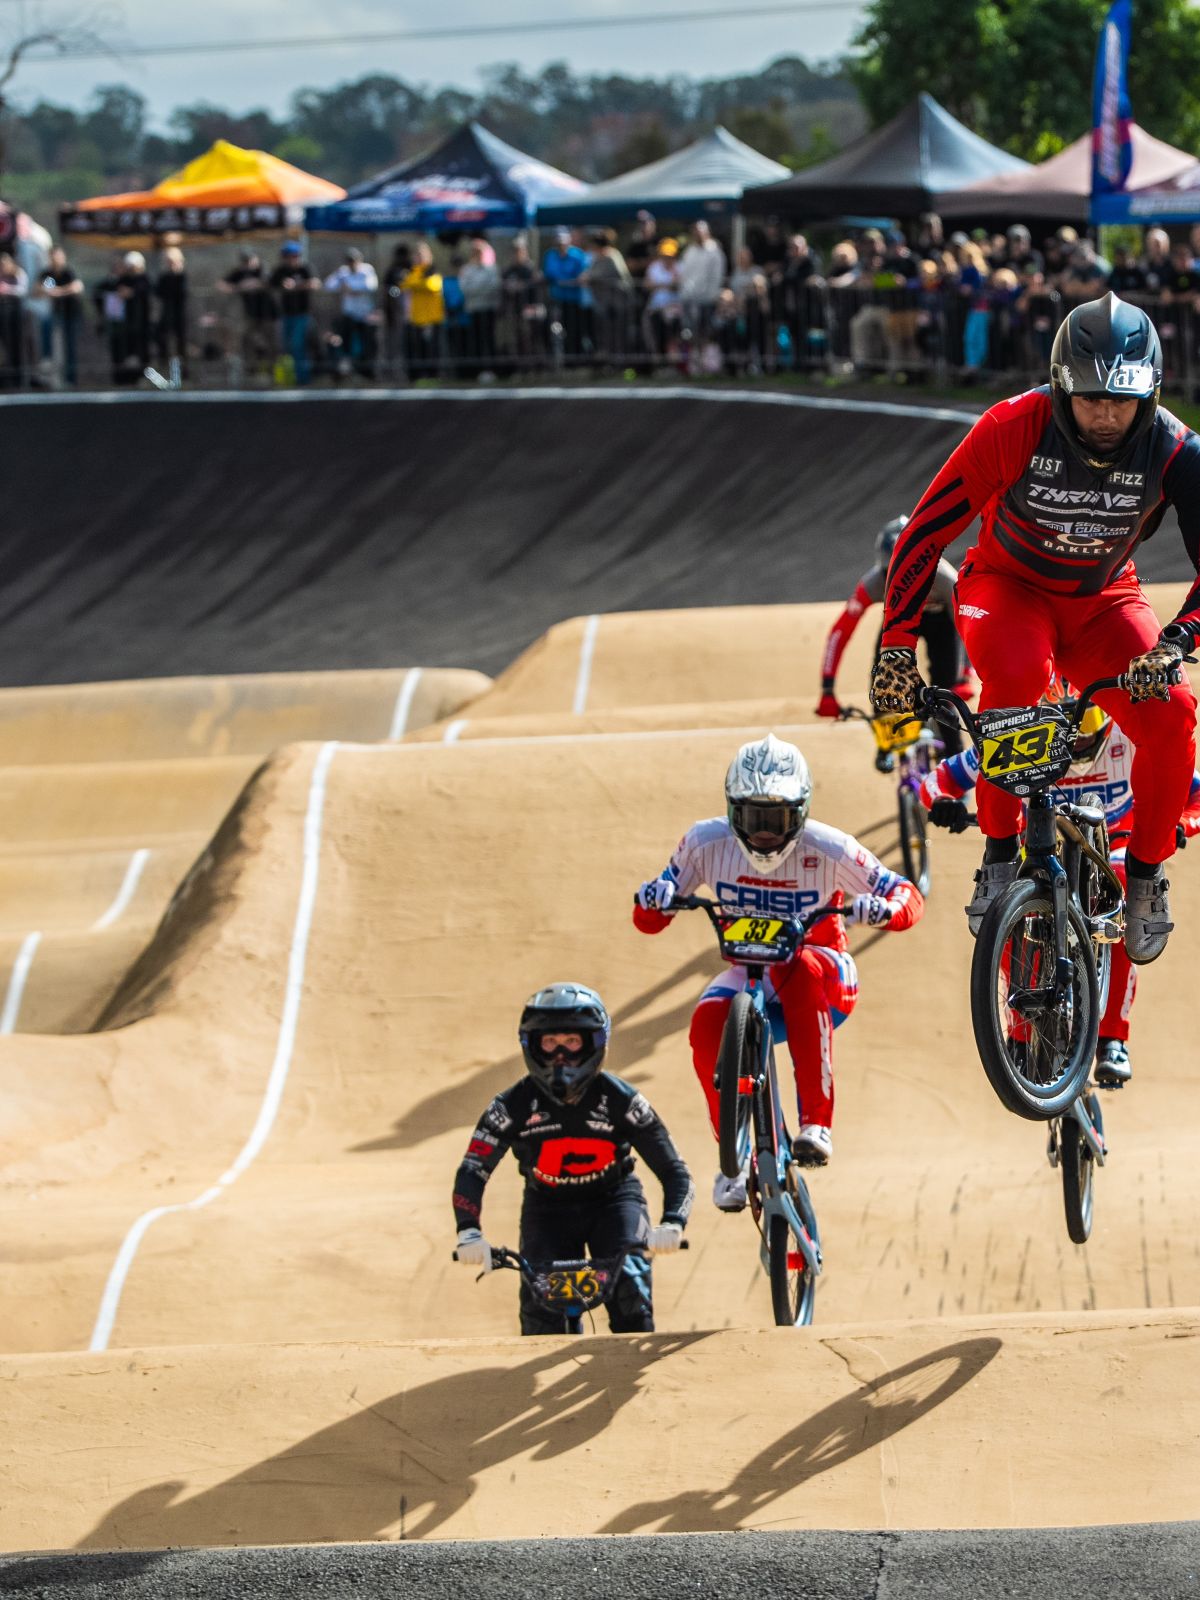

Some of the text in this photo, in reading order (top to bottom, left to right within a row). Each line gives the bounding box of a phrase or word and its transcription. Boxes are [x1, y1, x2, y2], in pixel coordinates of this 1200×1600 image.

[1031, 456, 1062, 473] FIST
[1113, 472, 1143, 486] FIZZ
[1043, 540, 1113, 554] OAKLEY
[875, 696, 911, 707] FIST
[981, 711, 1036, 734] PROPHECY
[987, 726, 1050, 771] 43
[1047, 748, 1063, 758] FIST
[716, 880, 820, 914] CRISP
[743, 919, 771, 941] 33
[547, 1271, 598, 1300] 216
